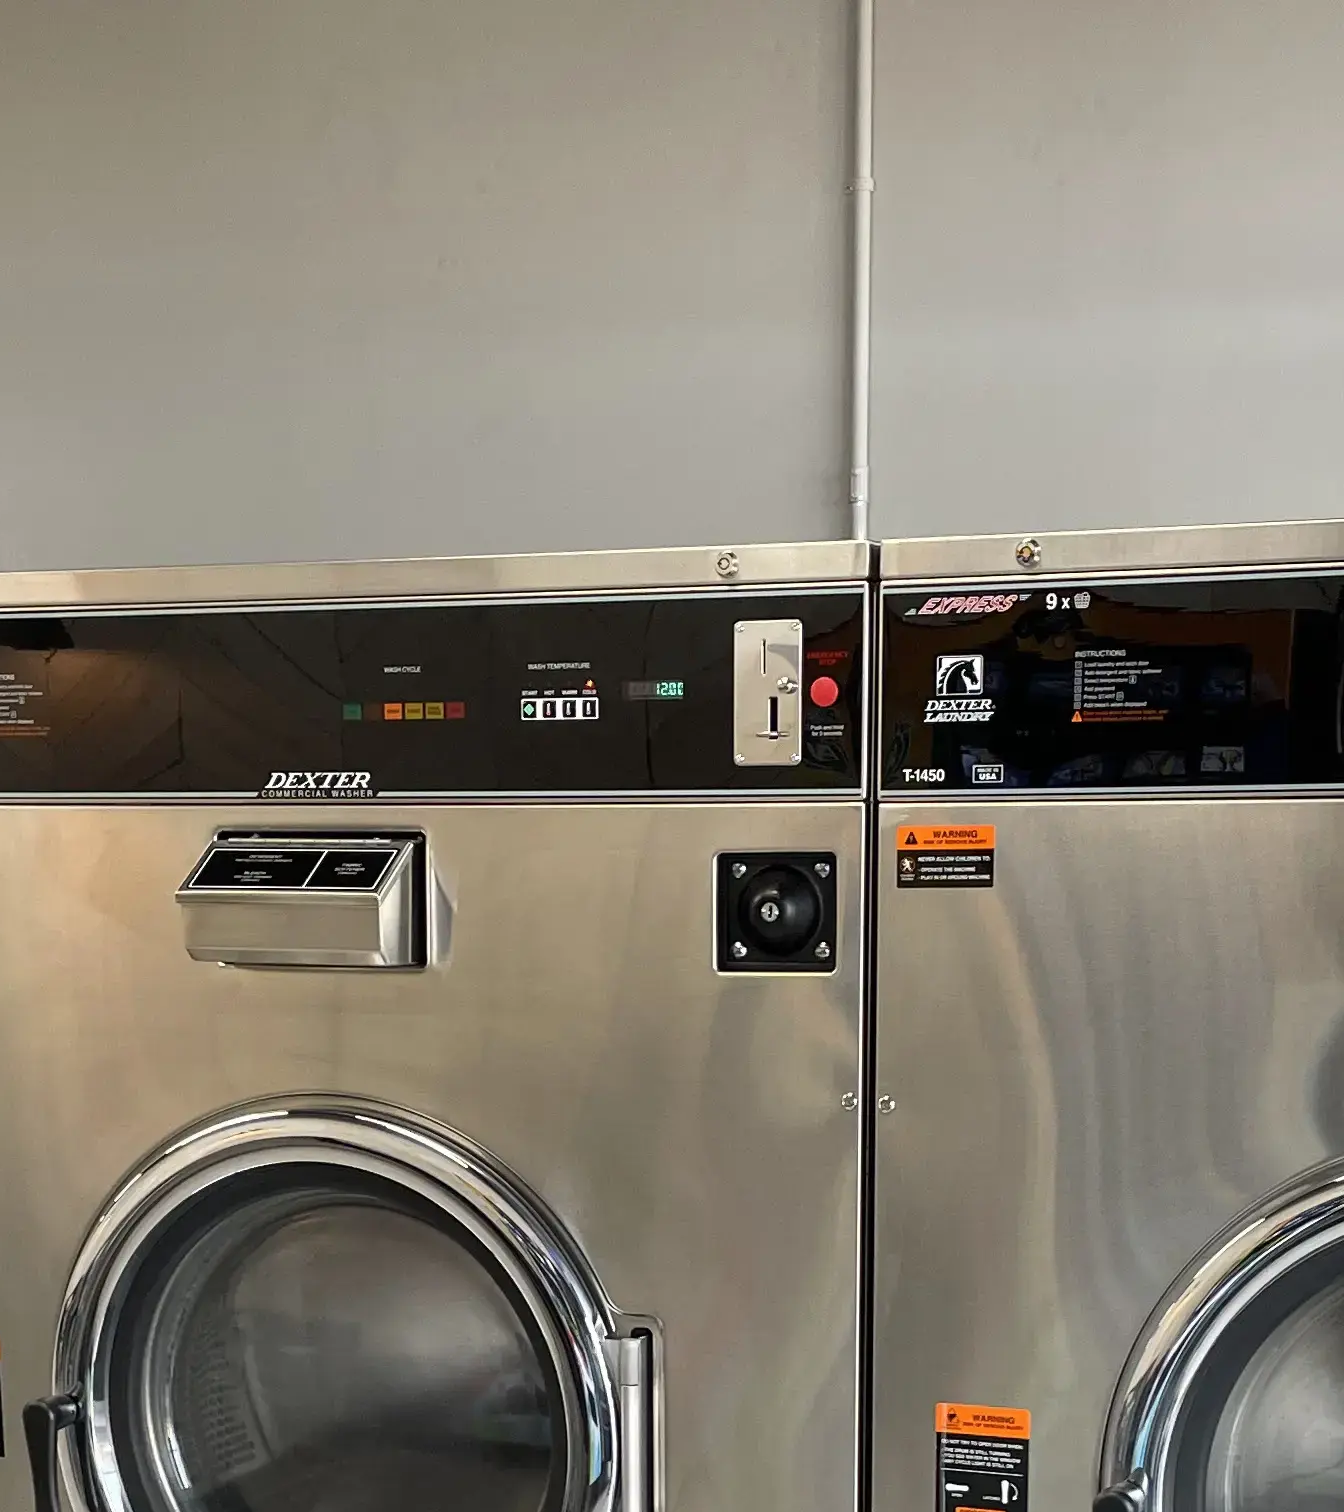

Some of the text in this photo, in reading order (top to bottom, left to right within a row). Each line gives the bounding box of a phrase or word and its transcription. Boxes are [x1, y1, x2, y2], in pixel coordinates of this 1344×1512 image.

[918, 594, 1019, 615] EXPRESS
[1046, 593, 1057, 610] 9
[924, 699, 992, 711] DEXTER
[924, 711, 994, 722] LAUNDRY
[265, 772, 371, 789] DEXTER
[903, 769, 945, 782] T-1450
[261, 789, 373, 798] COMMERCIAL WASHER
[933, 830, 978, 838] WARNING
[972, 1414, 1015, 1424] WARNING
